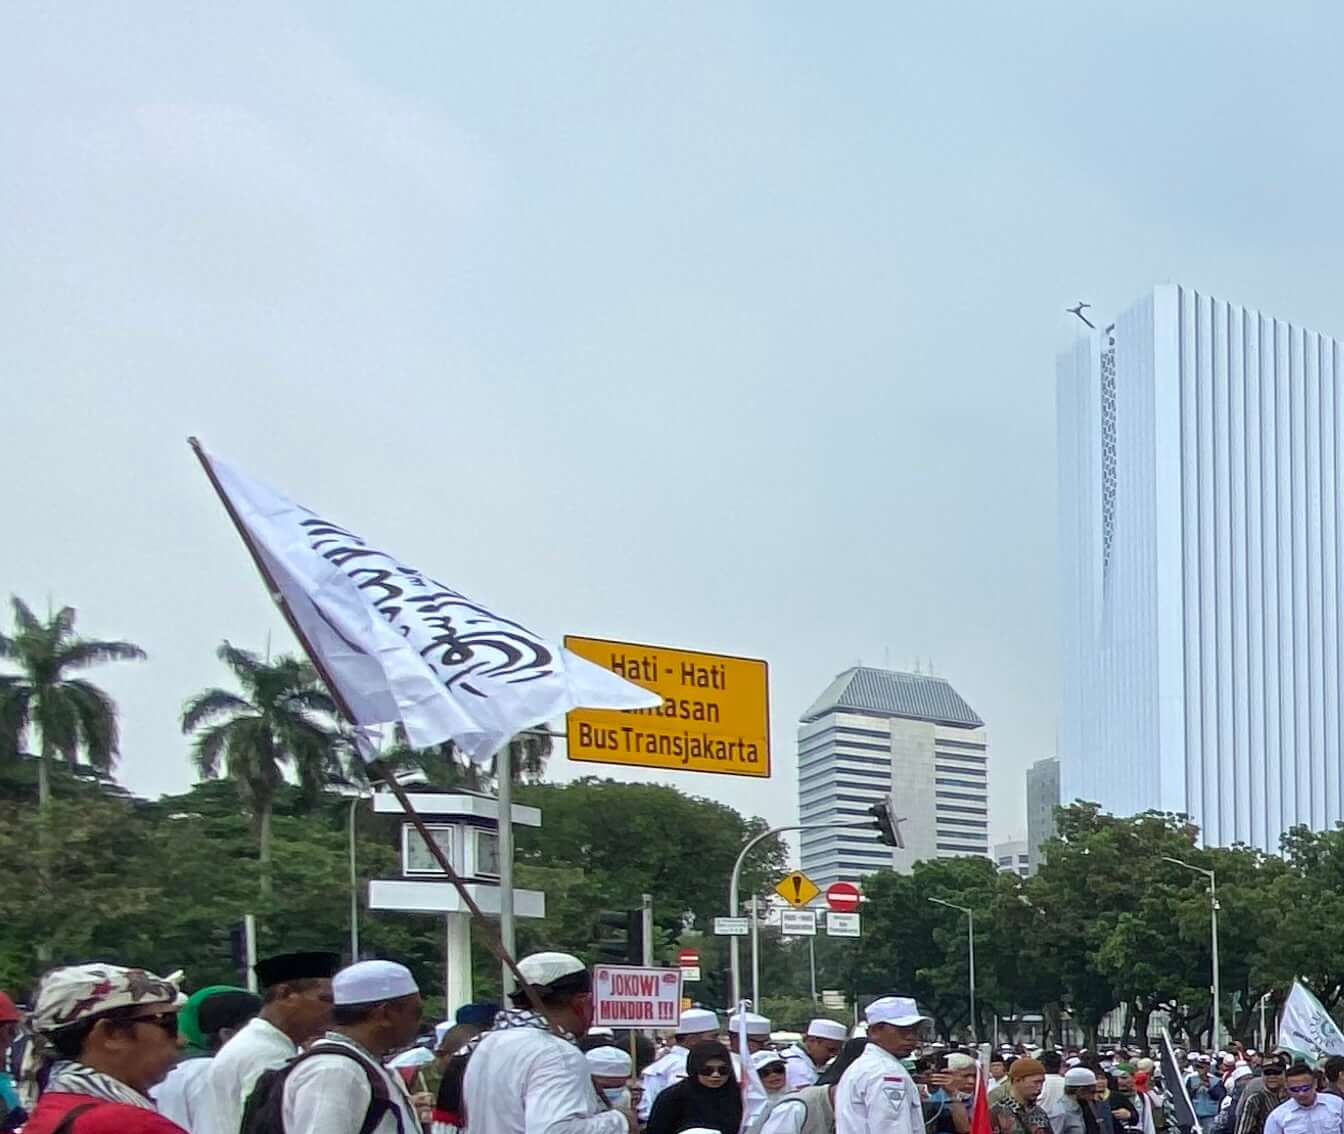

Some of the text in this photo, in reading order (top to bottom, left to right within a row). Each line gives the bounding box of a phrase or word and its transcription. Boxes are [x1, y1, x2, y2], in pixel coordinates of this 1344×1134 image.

[611, 653, 658, 682] Hati
[681, 661, 726, 690] Hati
[579, 722, 760, 764] Bus Transjakarta
[610, 974, 660, 997] JOKOWI
[600, 1000, 653, 1020] MUNDUR
